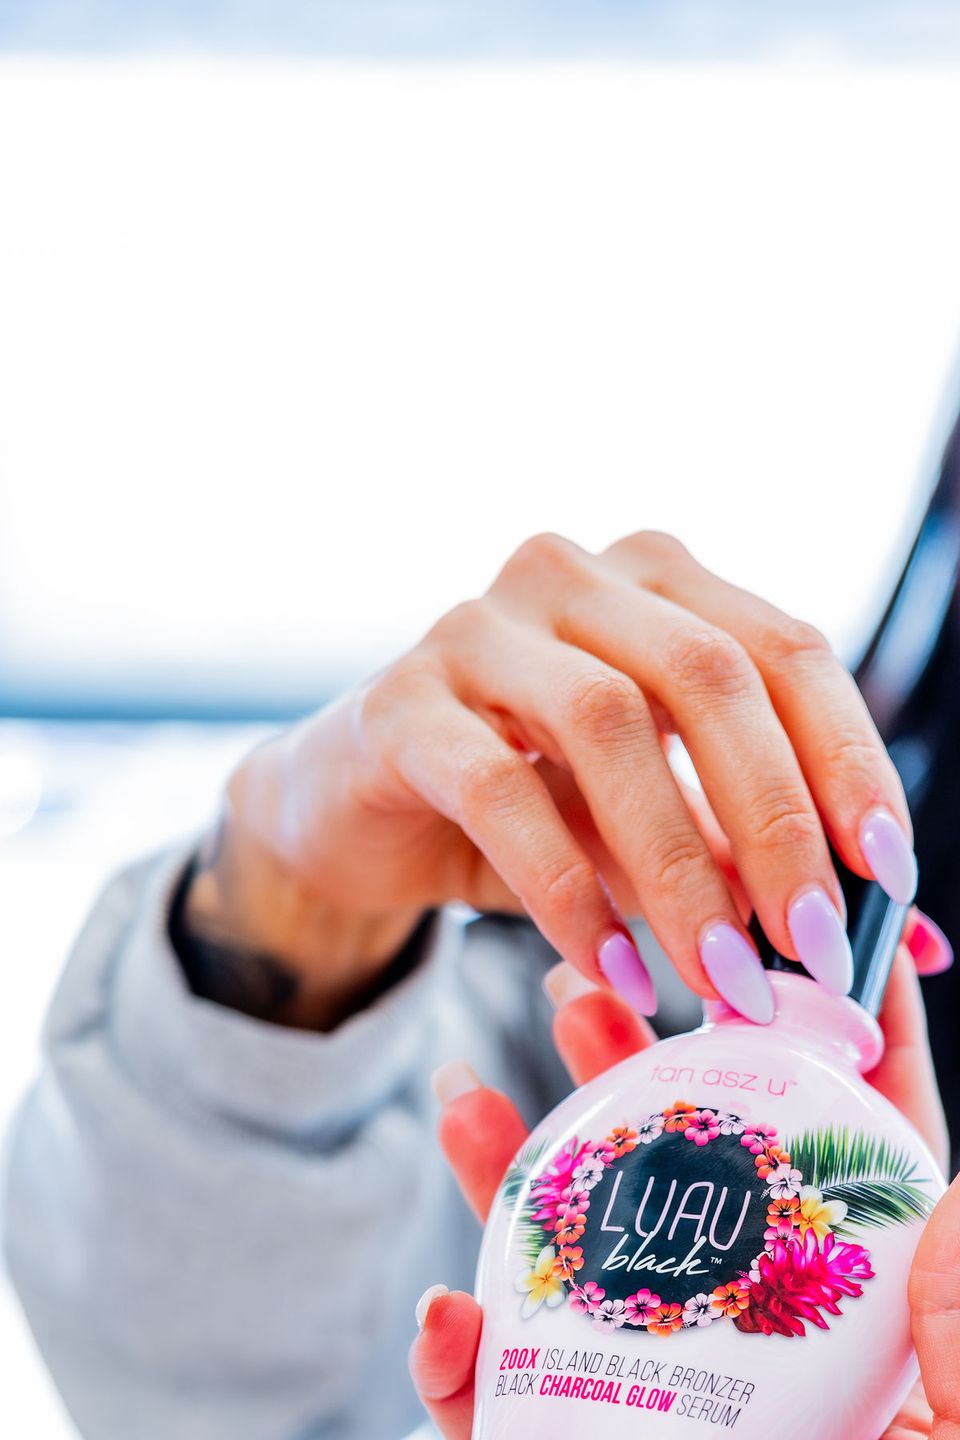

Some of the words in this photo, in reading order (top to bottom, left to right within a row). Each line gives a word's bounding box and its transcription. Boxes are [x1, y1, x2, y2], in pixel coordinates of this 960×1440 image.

[650, 1064, 695, 1084] tan
[702, 1068, 760, 1092] asz
[600, 1170, 752, 1251] LUAU
[601, 1231, 710, 1277] black
[495, 1373, 539, 1397] BLACK
[539, 1374, 622, 1405] CHARCOAL
[626, 1385, 677, 1412] GLOW
[676, 1394, 742, 1429] SERUM
[499, 1348, 541, 1371] 200X
[541, 1348, 604, 1374] ISLAND
[605, 1354, 668, 1383] BLACK
[668, 1365, 756, 1405] BRONZER
